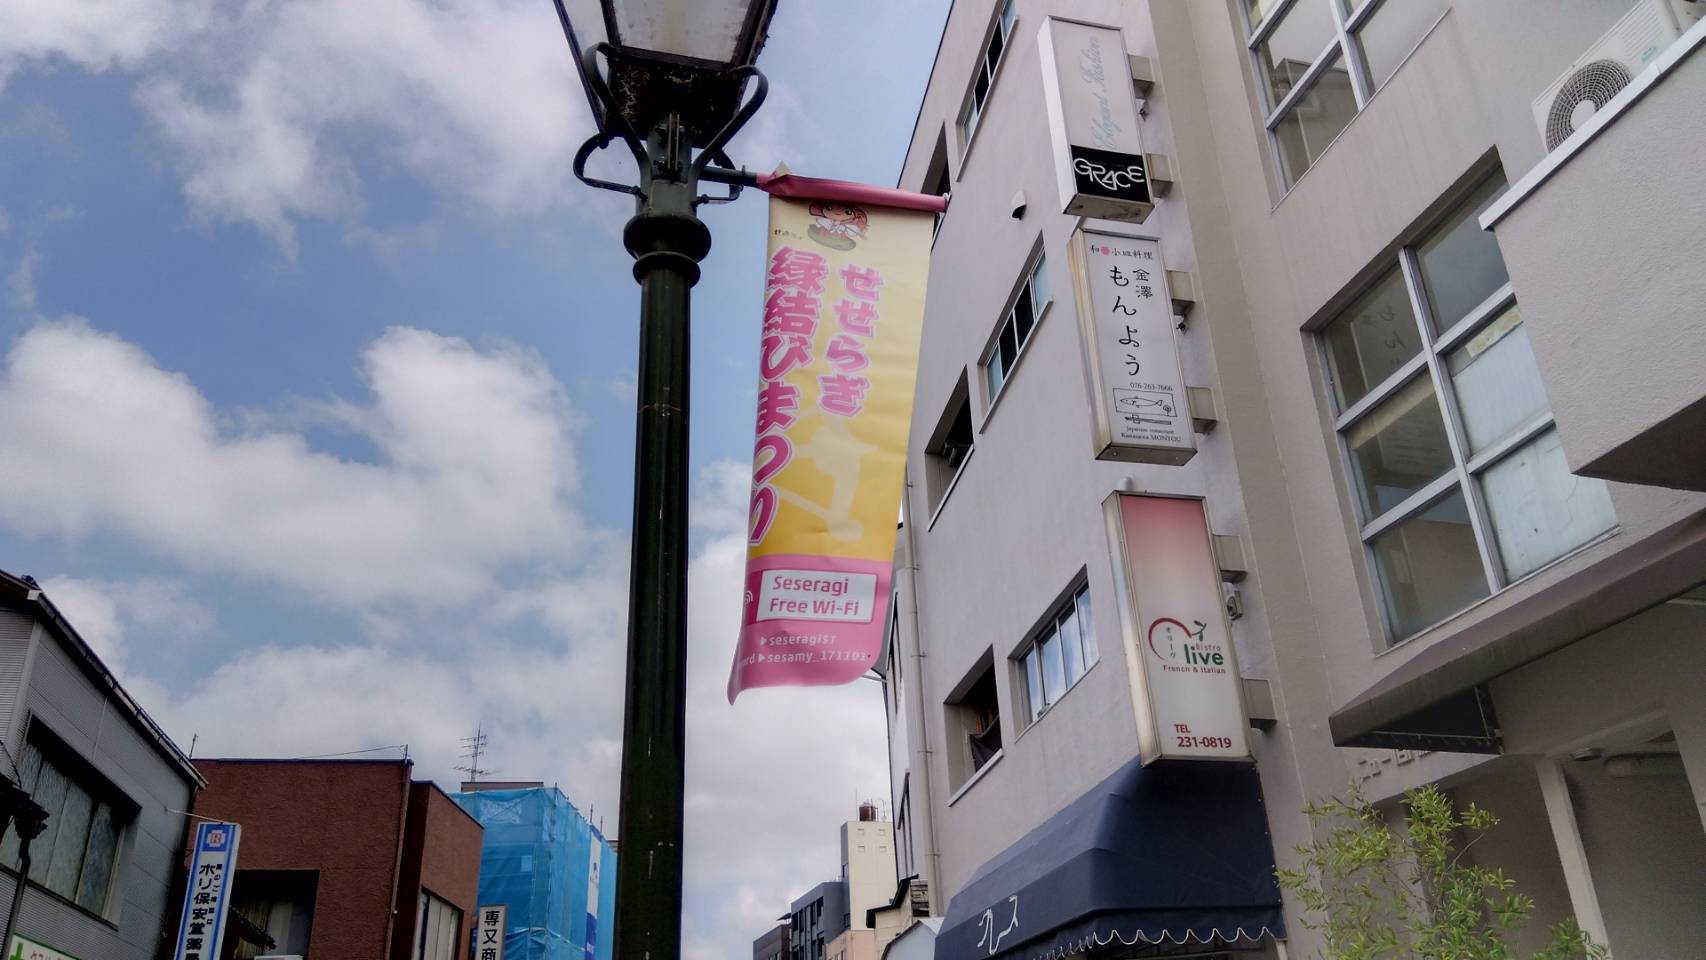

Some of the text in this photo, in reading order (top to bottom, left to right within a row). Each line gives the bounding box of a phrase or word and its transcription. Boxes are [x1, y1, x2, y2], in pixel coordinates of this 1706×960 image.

[1073, 158, 1145, 191] GRACE
[1133, 268, 1153, 299] 金澤
[1109, 266, 1139, 376] もんよう
[819, 264, 883, 417] せせらぎ
[749, 247, 828, 545] 縁結びまつり
[773, 576, 849, 596] Seseragi
[769, 597, 859, 616] Free Wi-Fi
[1163, 665, 1191, 673] French
[1174, 724, 1191, 733] TEL
[1177, 736, 1232, 748] 231-0819
